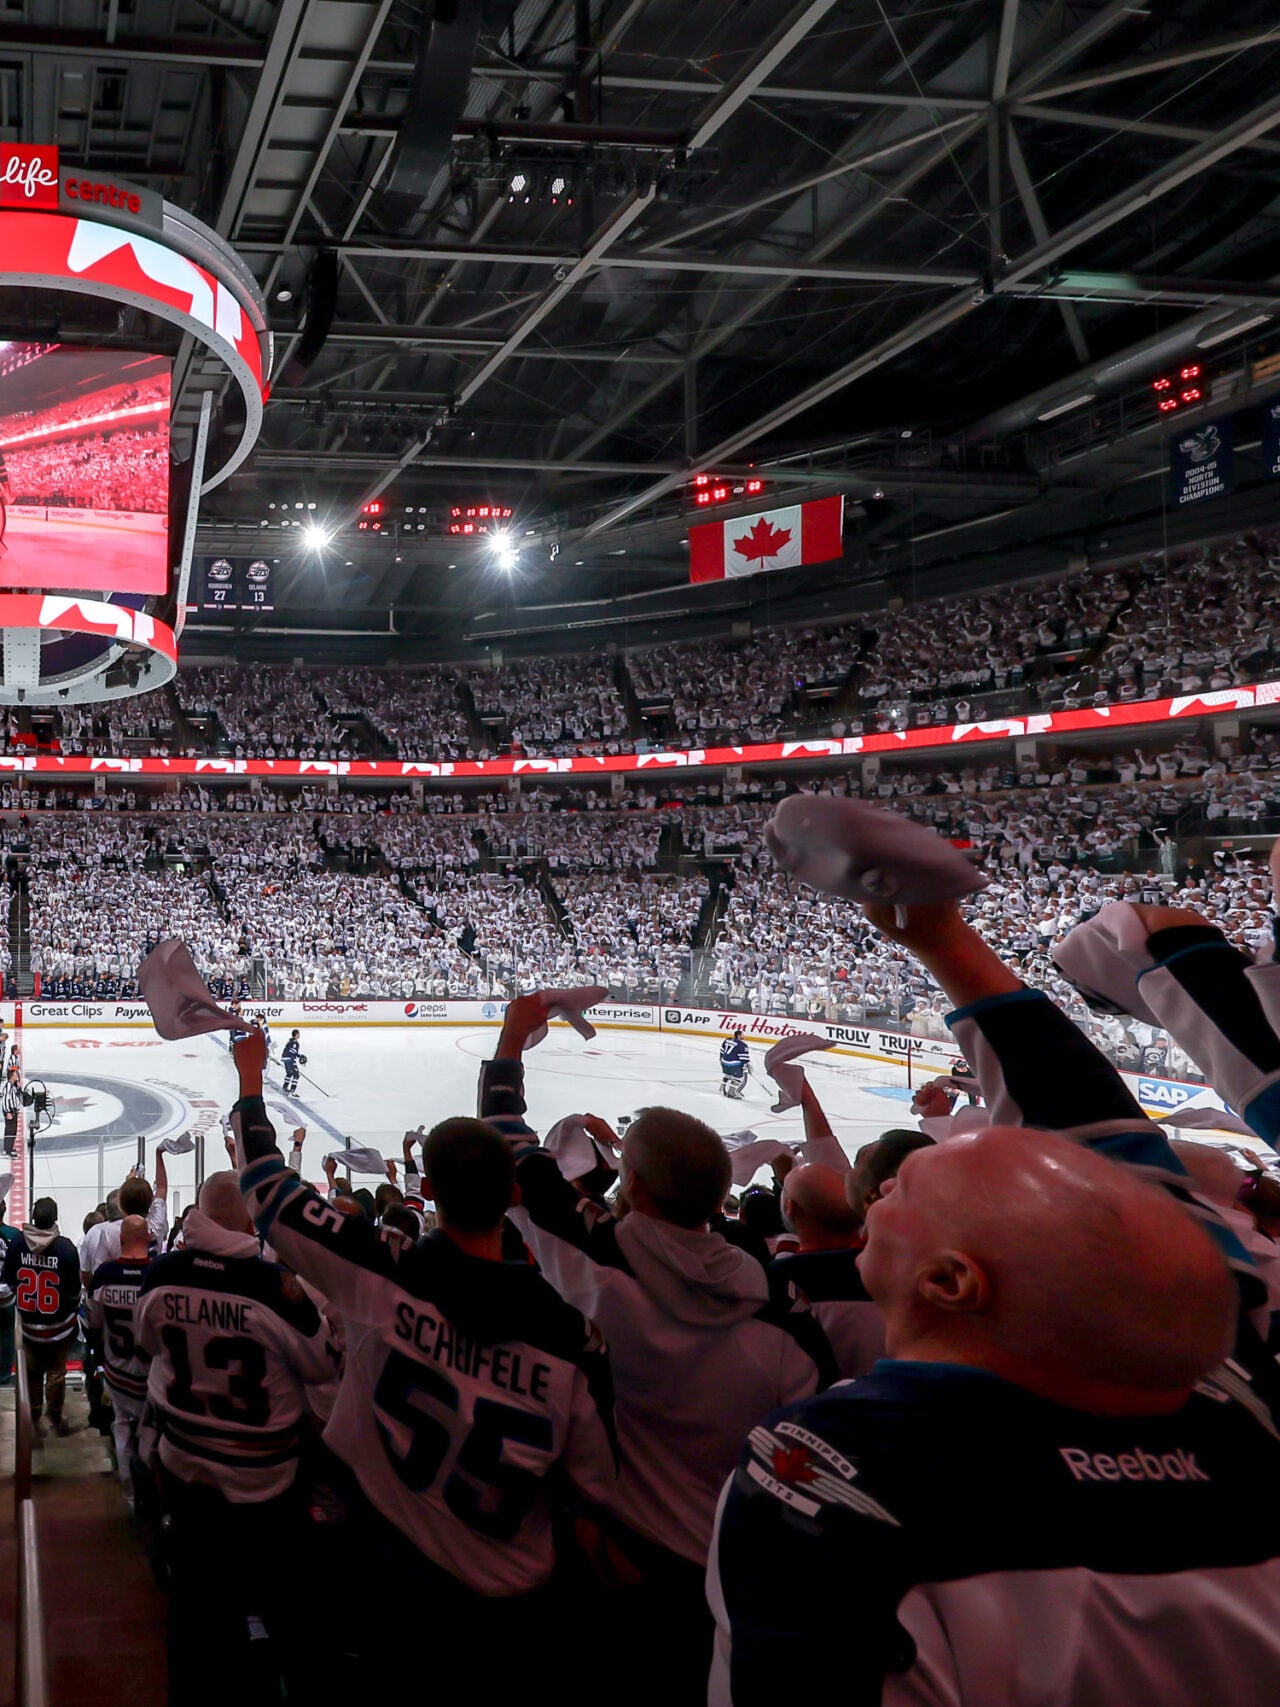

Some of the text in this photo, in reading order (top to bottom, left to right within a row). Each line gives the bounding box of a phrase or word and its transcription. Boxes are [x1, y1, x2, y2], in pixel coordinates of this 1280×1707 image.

[0, 156, 58, 198] life
[65, 177, 141, 213] centre
[1183, 476, 1220, 494] DIVISION
[1188, 470, 1214, 484] NORTH
[1179, 483, 1225, 504] CHAMPIONS
[214, 590, 226, 601] 27
[254, 591, 265, 602] 13
[30, 1004, 103, 1020] Great Clips
[303, 1003, 368, 1014] bodog.net
[420, 1003, 447, 1014] pepsi
[581, 1007, 651, 1020] nterprise
[717, 1014, 815, 1038] Tim Horton
[825, 1026, 870, 1044] TRULY
[879, 1034, 922, 1053] TRULY
[1139, 1082, 1189, 1106] SAP
[304, 1202, 345, 1234] 5
[20, 1252, 59, 1269] WHEELER
[193, 1257, 226, 1271] Reebok
[17, 1268, 60, 1314] 26
[163, 1293, 252, 1333] SELANNE
[394, 1301, 551, 1403] SCHEIFELE
[161, 1324, 270, 1427] 13
[372, 1348, 554, 1541] 55
[780, 1424, 851, 1473] WINNIPEG
[1059, 1446, 1210, 1483] Reebok
